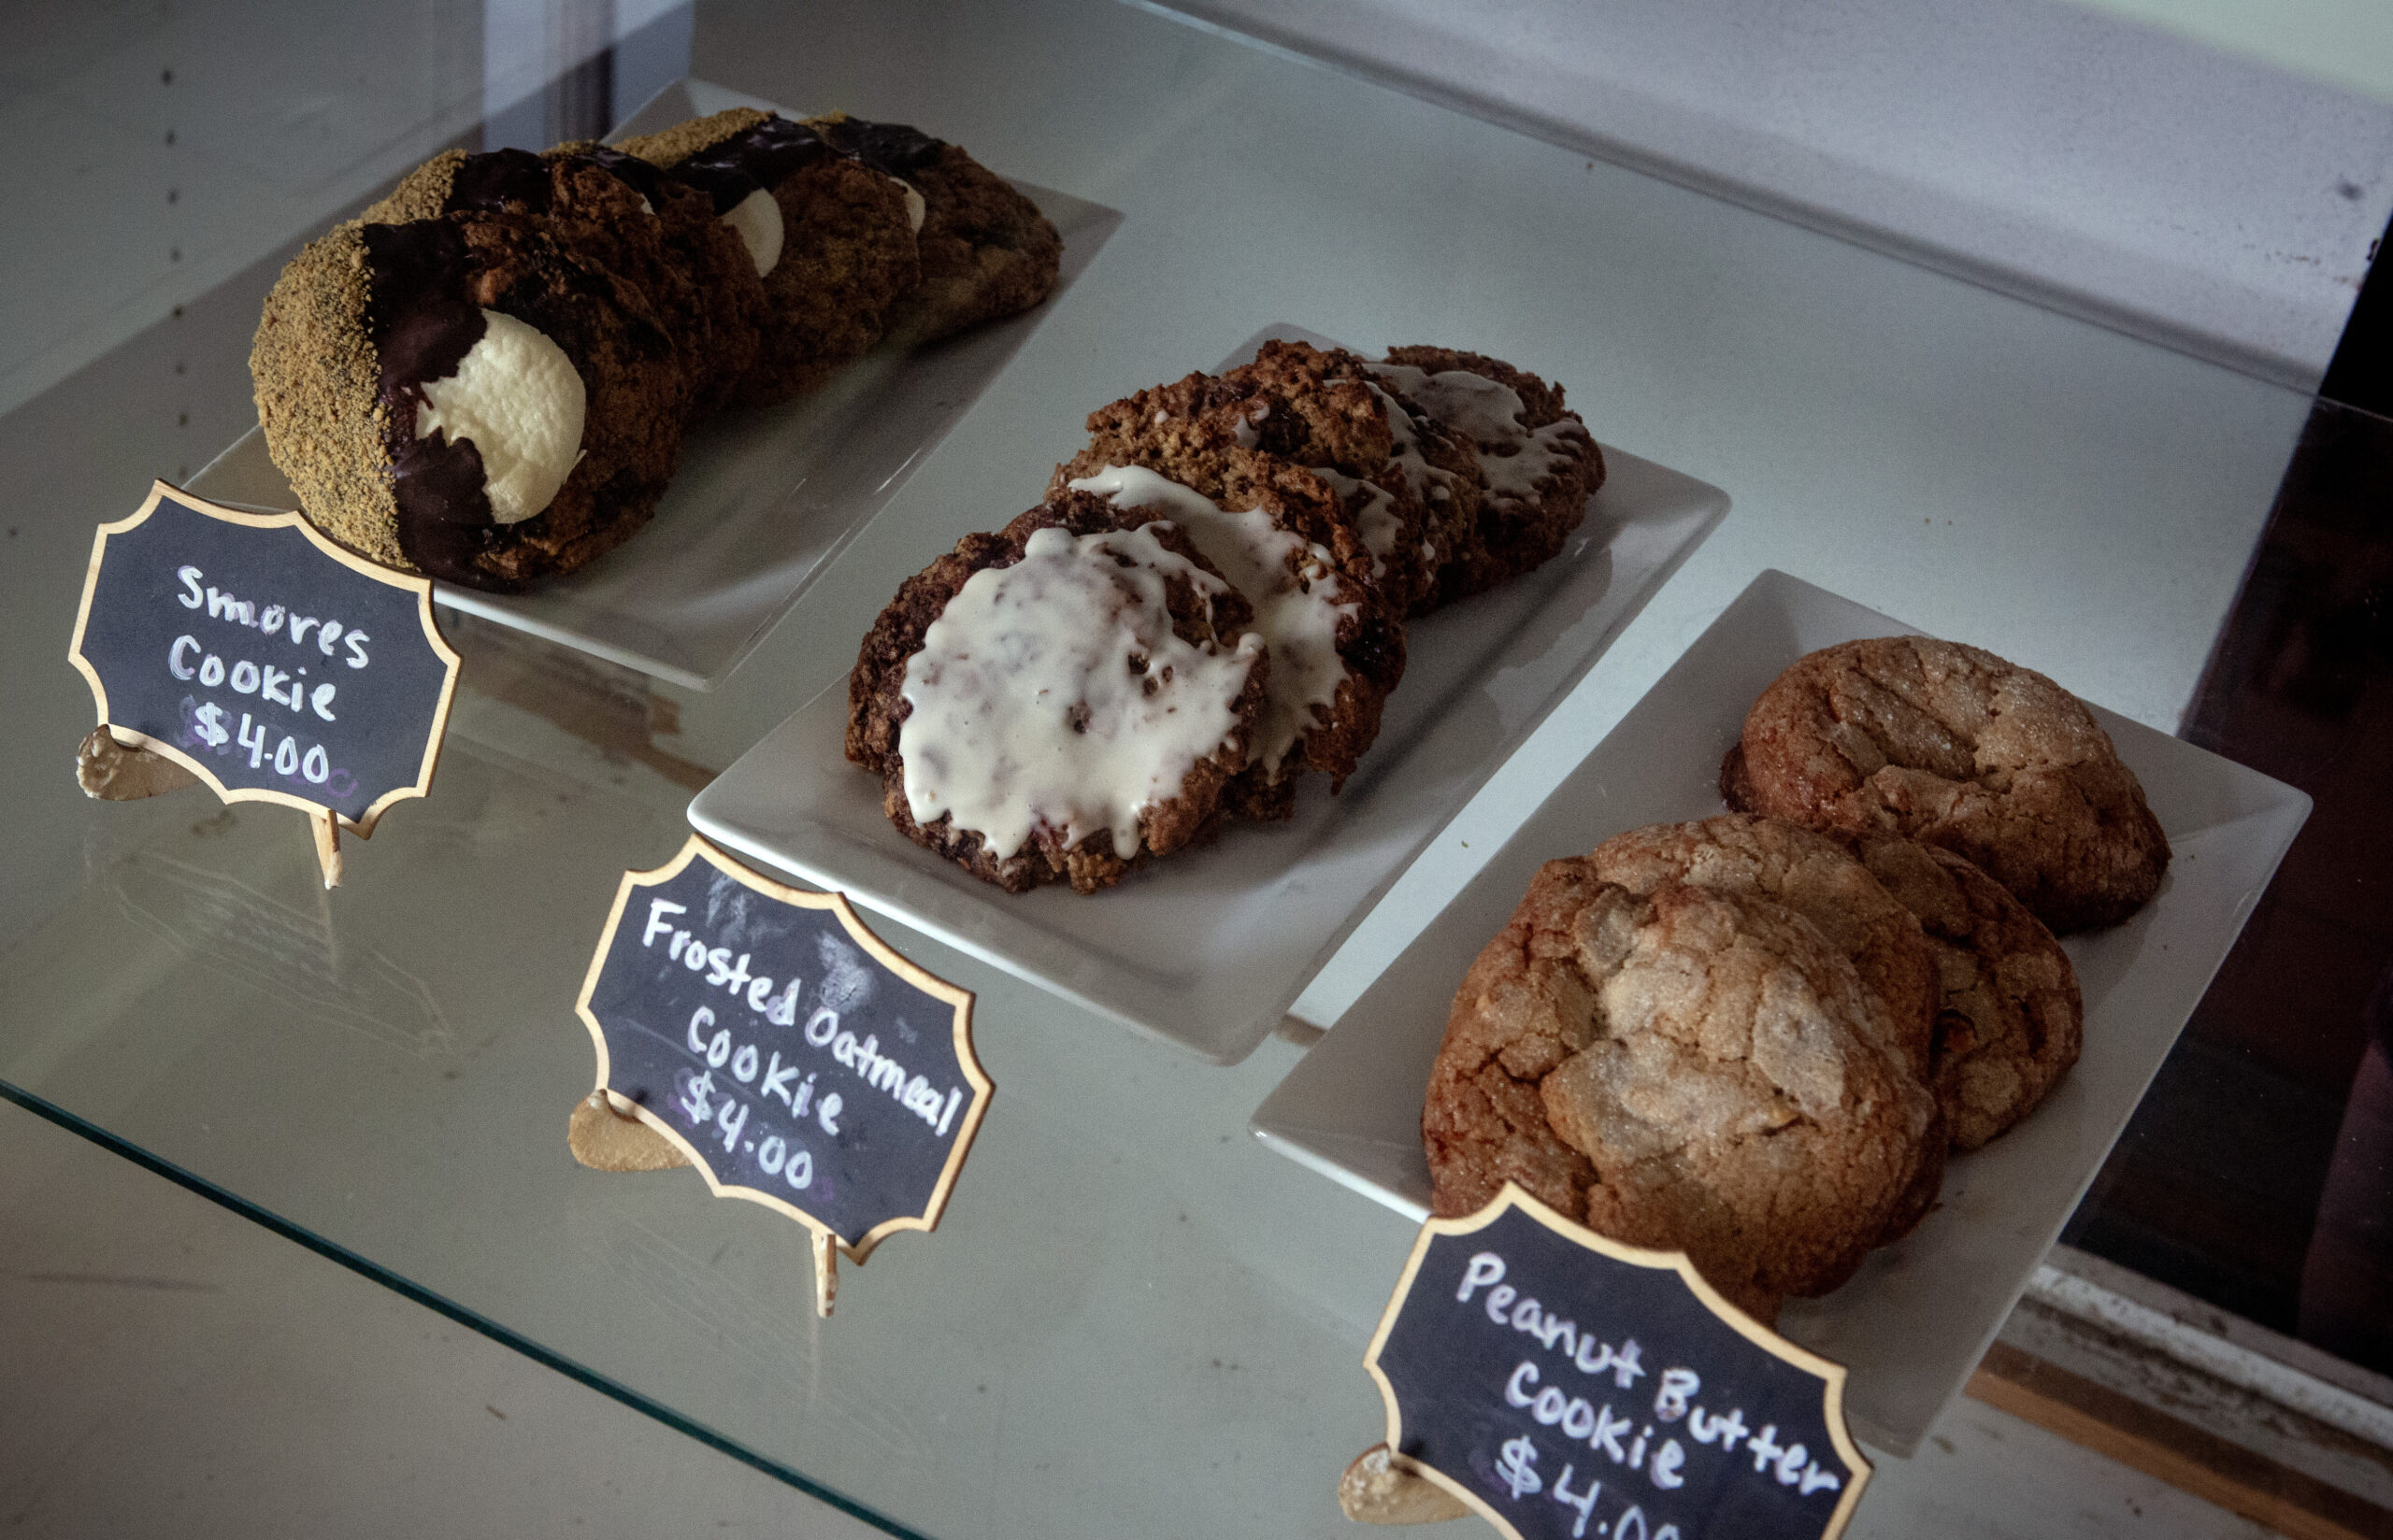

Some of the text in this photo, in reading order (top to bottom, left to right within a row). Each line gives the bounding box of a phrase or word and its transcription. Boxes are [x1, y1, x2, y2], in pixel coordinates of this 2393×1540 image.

[168, 635, 337, 720] Cookie
[178, 565, 369, 669] Smores
[642, 897, 963, 1137] Frosted Oatmeal
[688, 1005, 842, 1135] Cookie
[1455, 1252, 1840, 1495] Peanut Butter
[1506, 1362, 1684, 1490] Cookie
